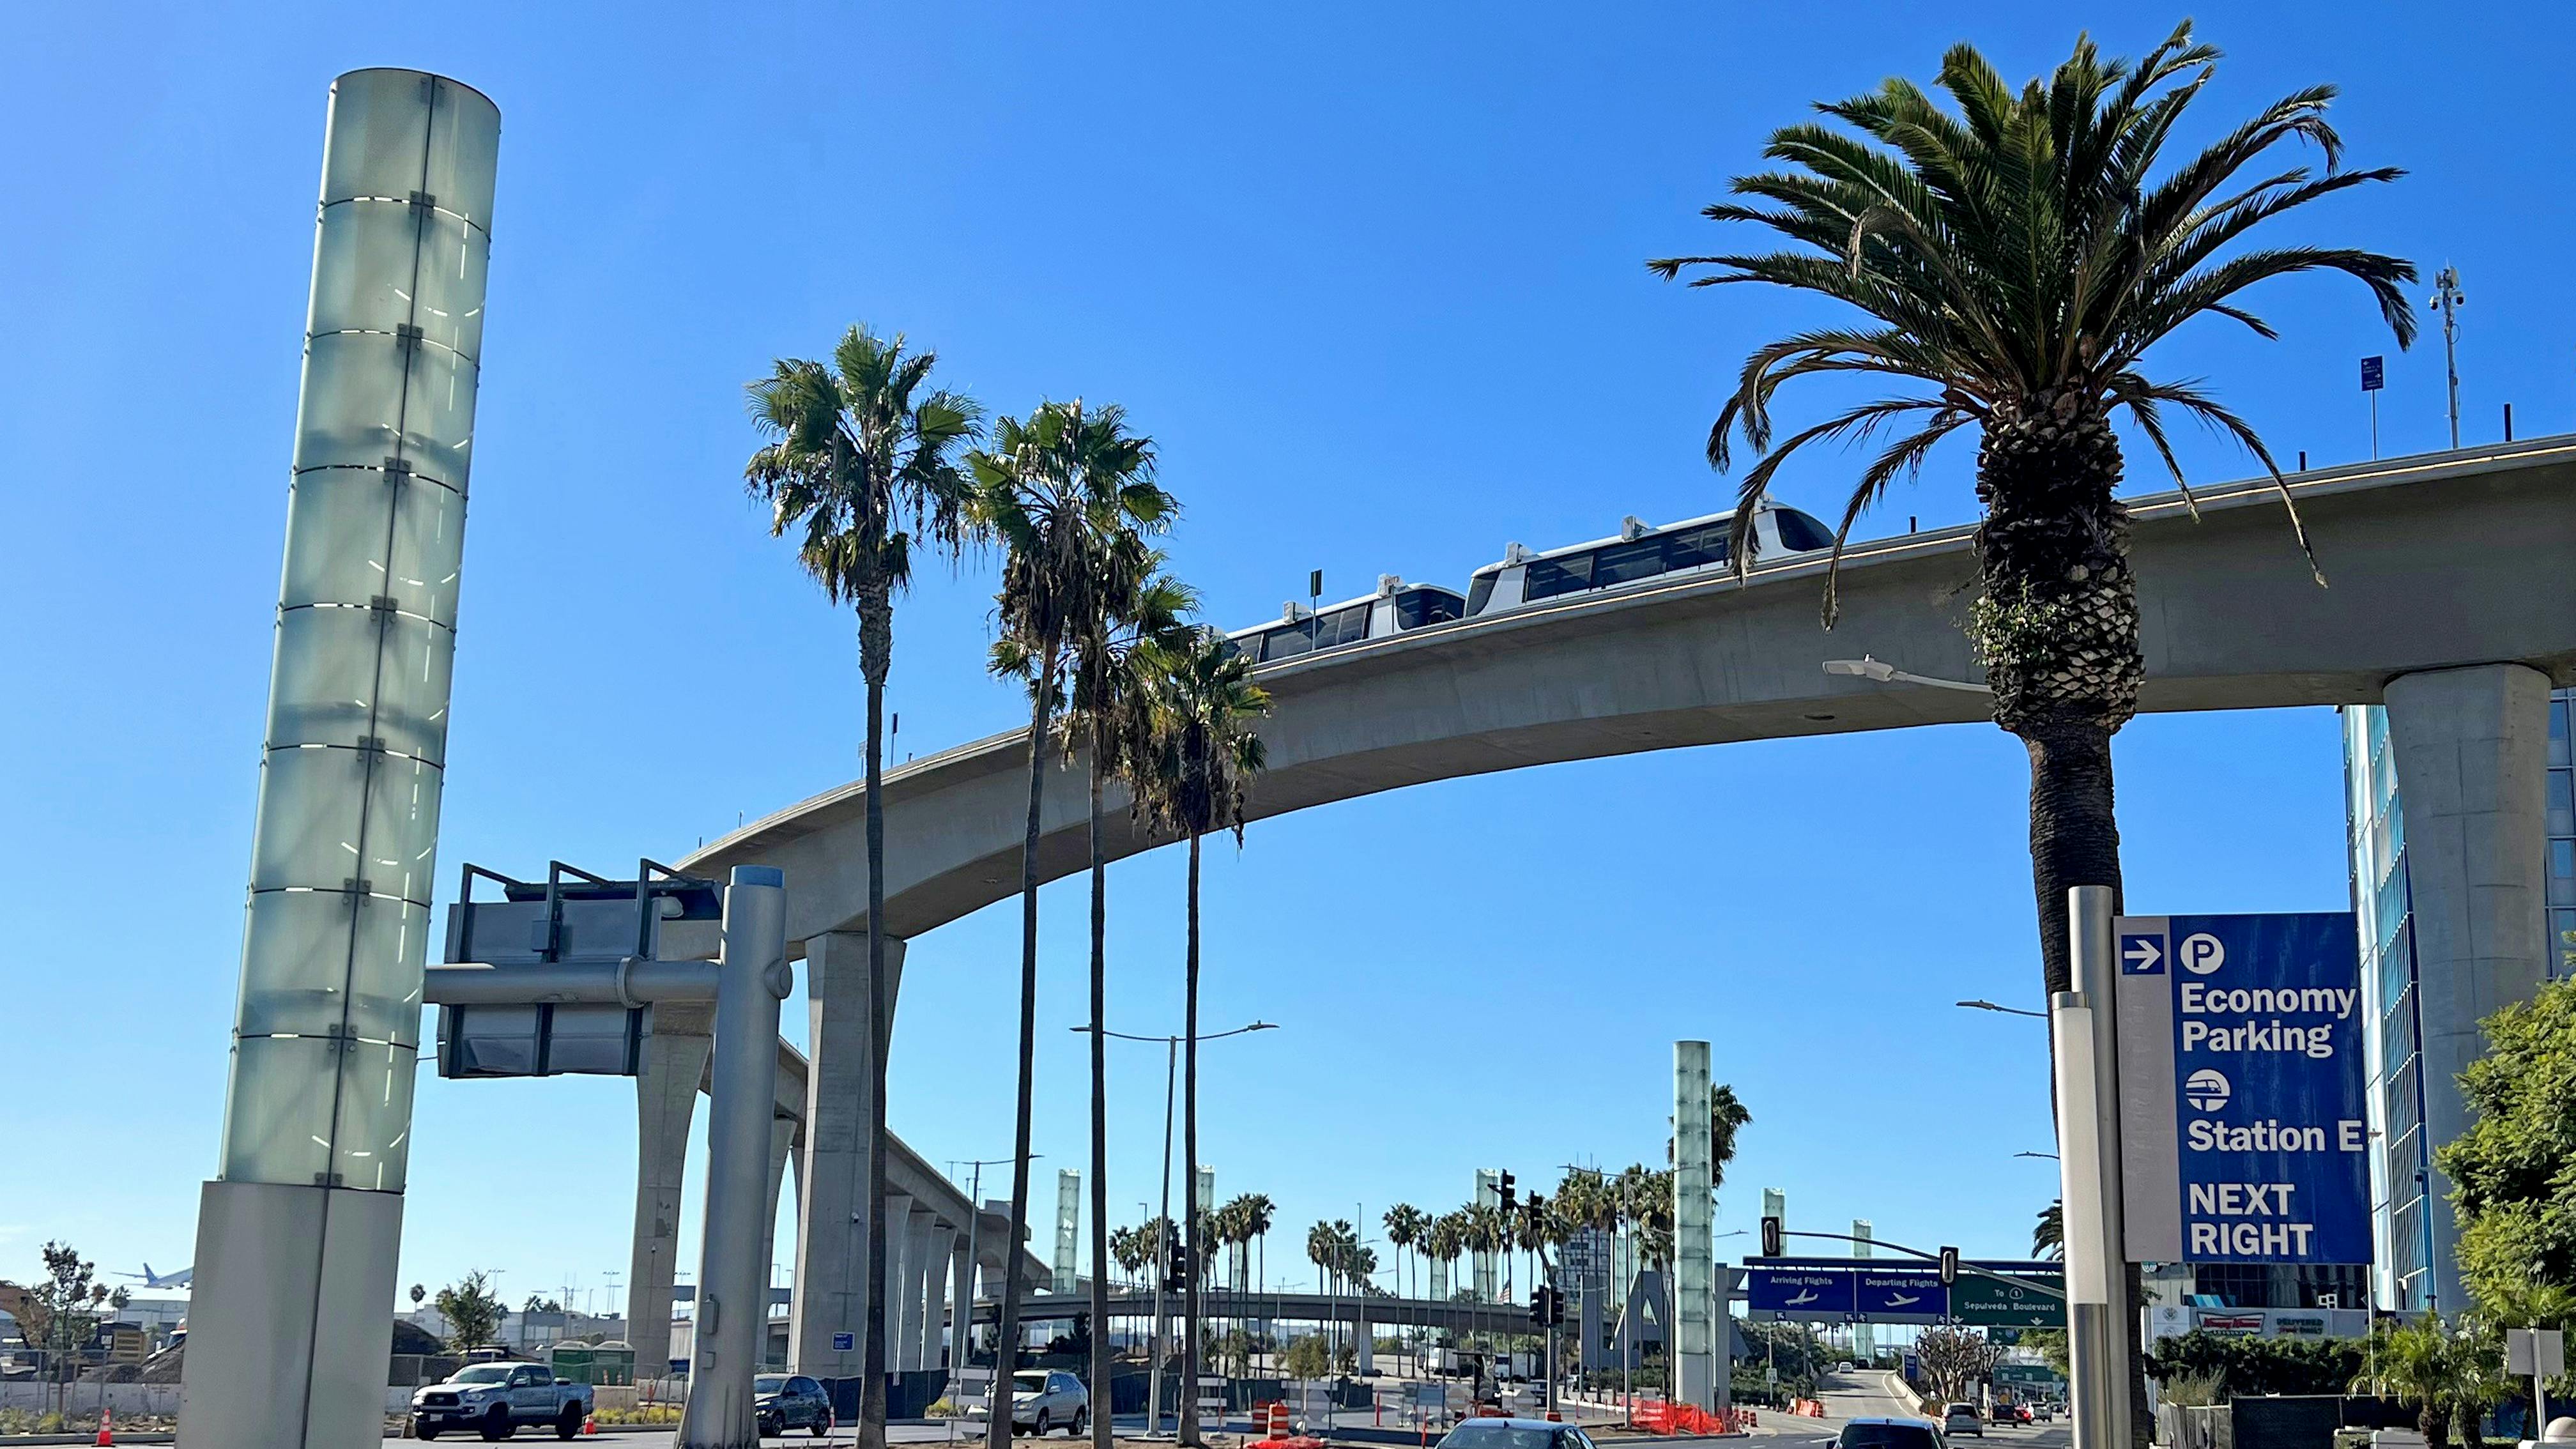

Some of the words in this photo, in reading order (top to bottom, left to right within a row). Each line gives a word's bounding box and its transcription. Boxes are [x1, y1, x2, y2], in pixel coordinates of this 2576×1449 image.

[2181, 982, 2356, 1020] Economy
[2182, 1020, 2333, 1058] Parking
[2188, 1119, 2326, 1152] Station
[2338, 1119, 2363, 1152] E
[2189, 1183, 2296, 1216] NEXT
[2191, 1222, 2313, 1256] RIGHT
[1770, 1276, 1802, 1285] Arriving
[1805, 1276, 1833, 1285] Flights
[1866, 1278, 1907, 1287] Departing
[1909, 1279, 1938, 1287] Flights
[1995, 1289, 2004, 1298] To
[1964, 1301, 2007, 1311] Sepulveda
[2013, 1303, 2056, 1311] Boulevard
